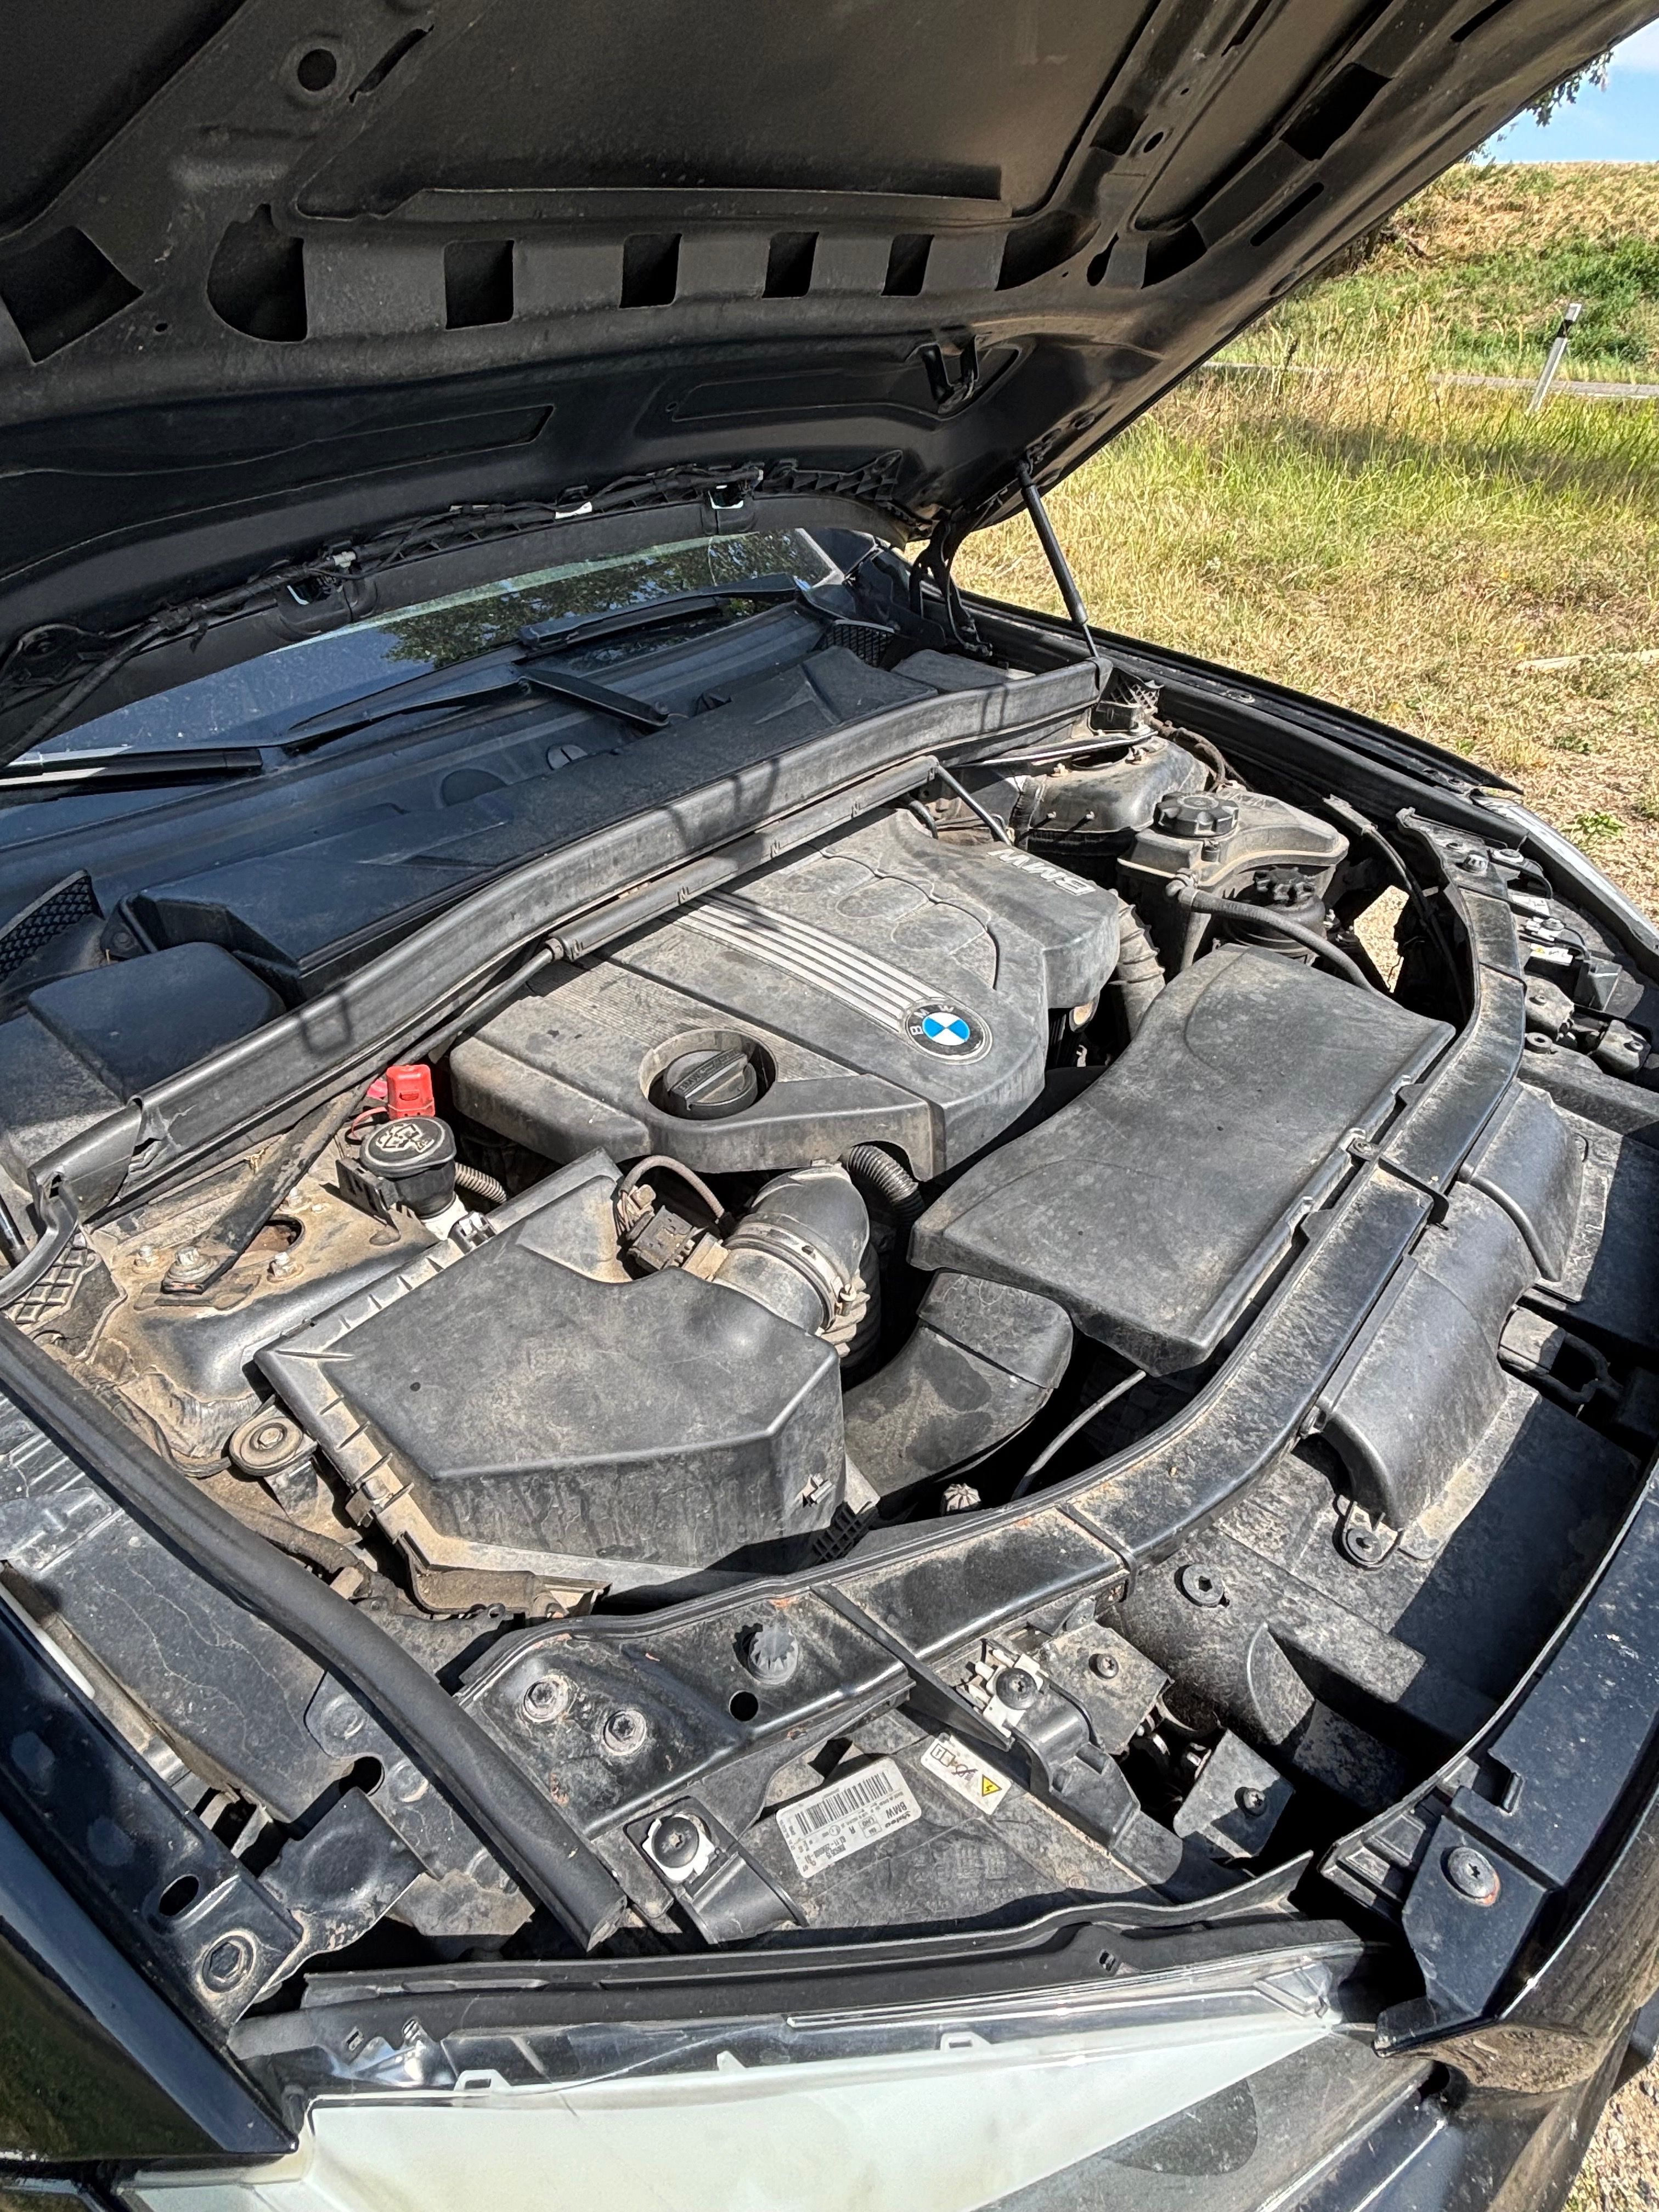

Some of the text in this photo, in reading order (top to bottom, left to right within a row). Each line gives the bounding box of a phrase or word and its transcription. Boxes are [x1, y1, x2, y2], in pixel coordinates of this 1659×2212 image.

[986, 849, 1096, 896] BMW
[910, 1005, 955, 1036] BMW
[885, 1801, 907, 1819] BMW
